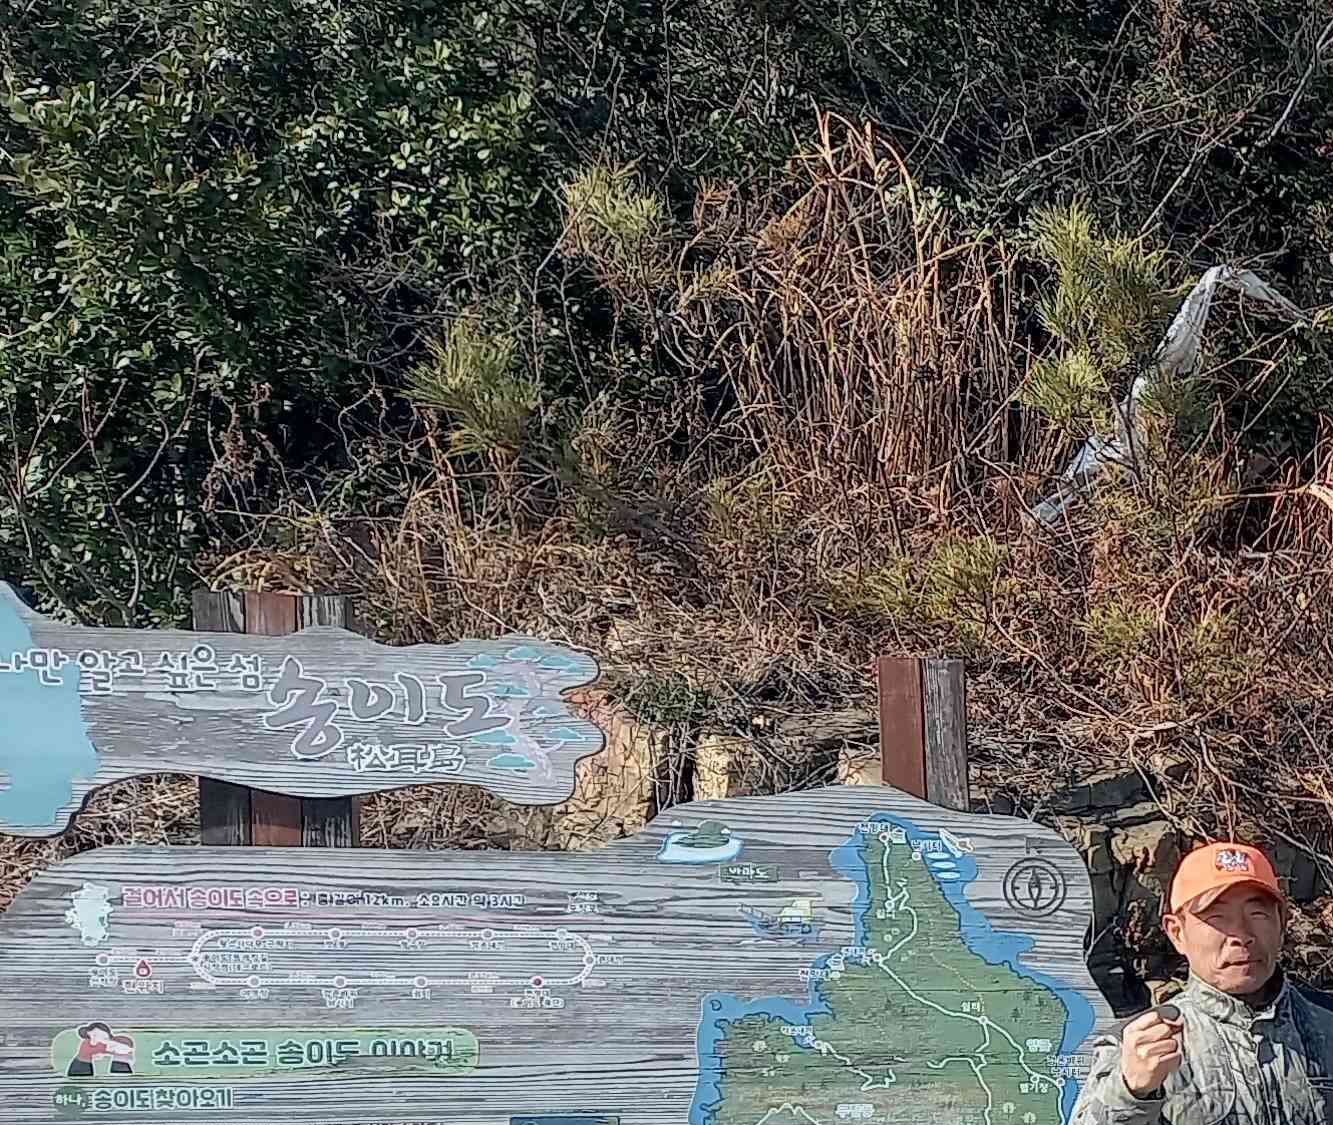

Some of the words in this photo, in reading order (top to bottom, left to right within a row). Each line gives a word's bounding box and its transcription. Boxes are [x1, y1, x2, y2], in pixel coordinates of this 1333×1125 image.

[79, 649, 145, 692] 알고
[158, 645, 219, 689] 싶은
[230, 654, 262, 689] 섬
[122, 887, 186, 908] 걸어서
[189, 887, 246, 908] 송이도
[247, 888, 300, 909] 속으로
[152, 1039, 270, 1067] 소곤소곤
[277, 1038, 361, 1067] 송이도
[94, 1087, 151, 1110] 송이도
[154, 1087, 234, 1110] 찾아오기
